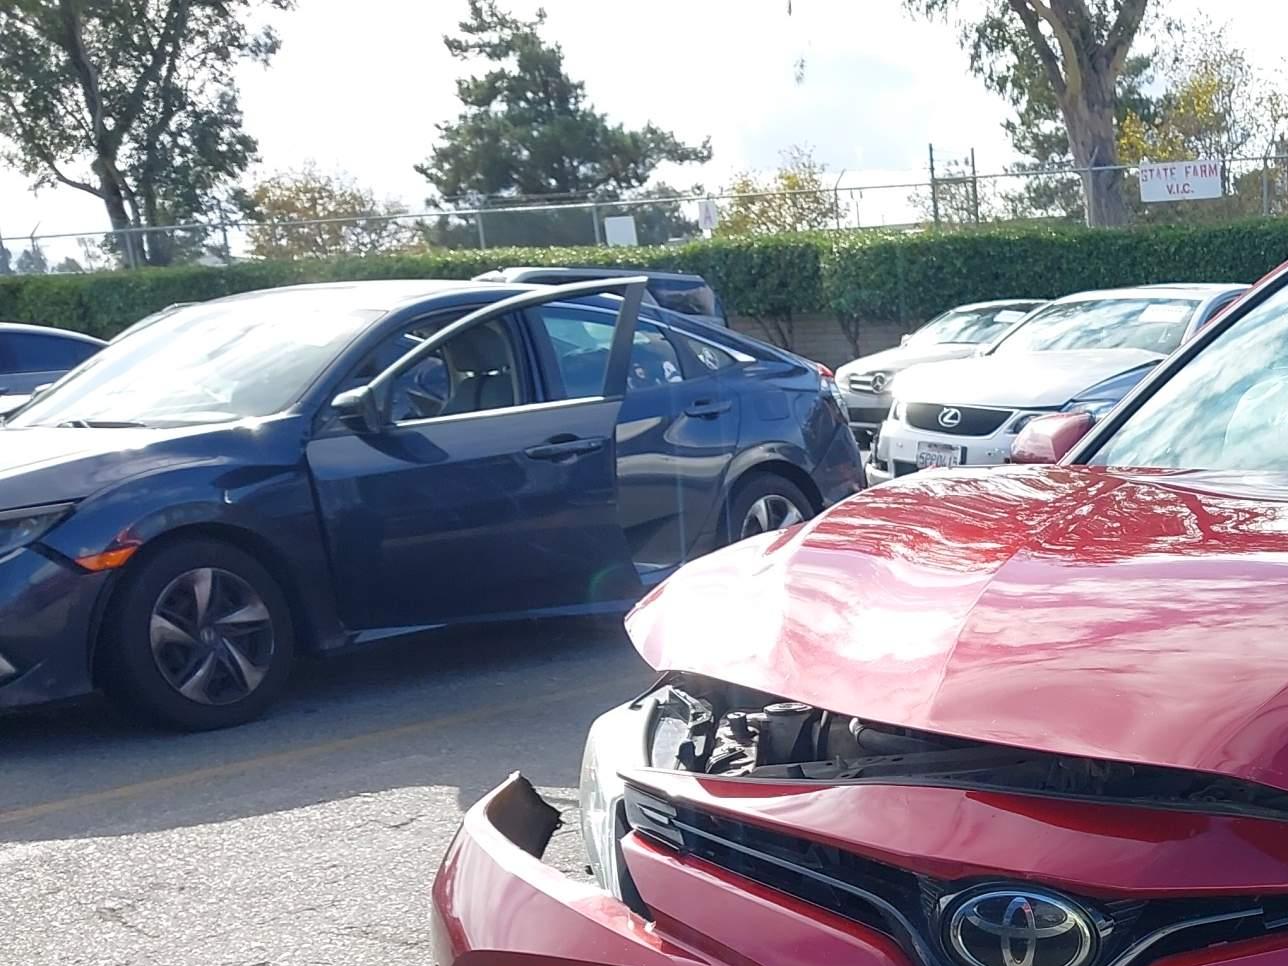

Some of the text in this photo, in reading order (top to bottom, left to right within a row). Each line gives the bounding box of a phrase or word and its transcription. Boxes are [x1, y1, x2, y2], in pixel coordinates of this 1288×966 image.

[1140, 163, 1218, 182] STATE FARM
[1166, 183, 1195, 195] V.I.C.
